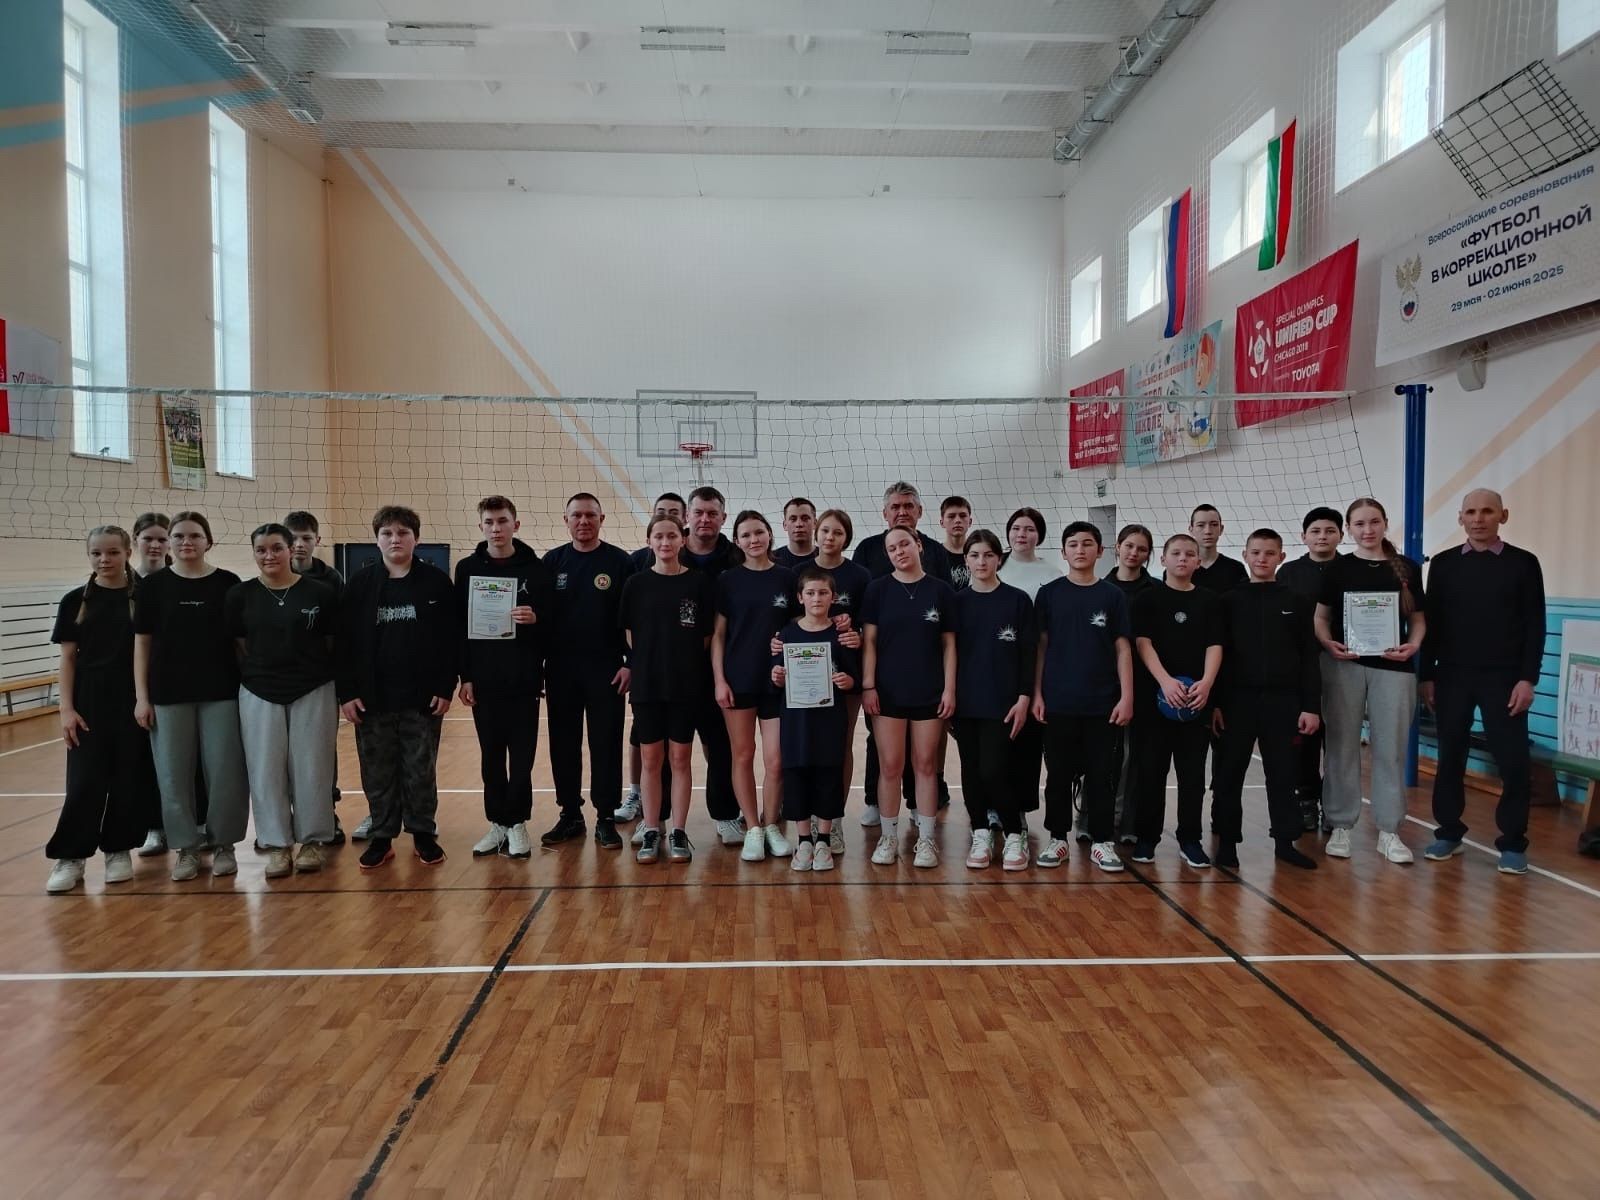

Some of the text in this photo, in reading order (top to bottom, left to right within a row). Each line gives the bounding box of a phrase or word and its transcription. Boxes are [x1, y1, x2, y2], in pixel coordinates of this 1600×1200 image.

[1428, 165, 1594, 246] Всероссийские соревнования
[1460, 205, 1541, 249] «ФУТБОЛ
[1430, 204, 1593, 284] В КОРРЕКЦИОННОЙ
[1451, 299, 1463, 312] 29
[1463, 295, 1482, 308] мая
[1487, 288, 1501, 299] 02
[1502, 279, 1531, 296] июня
[1533, 265, 1565, 284] 2025
[1467, 252, 1537, 288] ШКОЛЕ»
[1275, 304, 1338, 348] UNIFIED CUP
[1276, 295, 1324, 326] SPECIAL OLYMPICS
[1274, 345, 1297, 363] CHICAGO
[1292, 362, 1320, 381] TOYOTA
